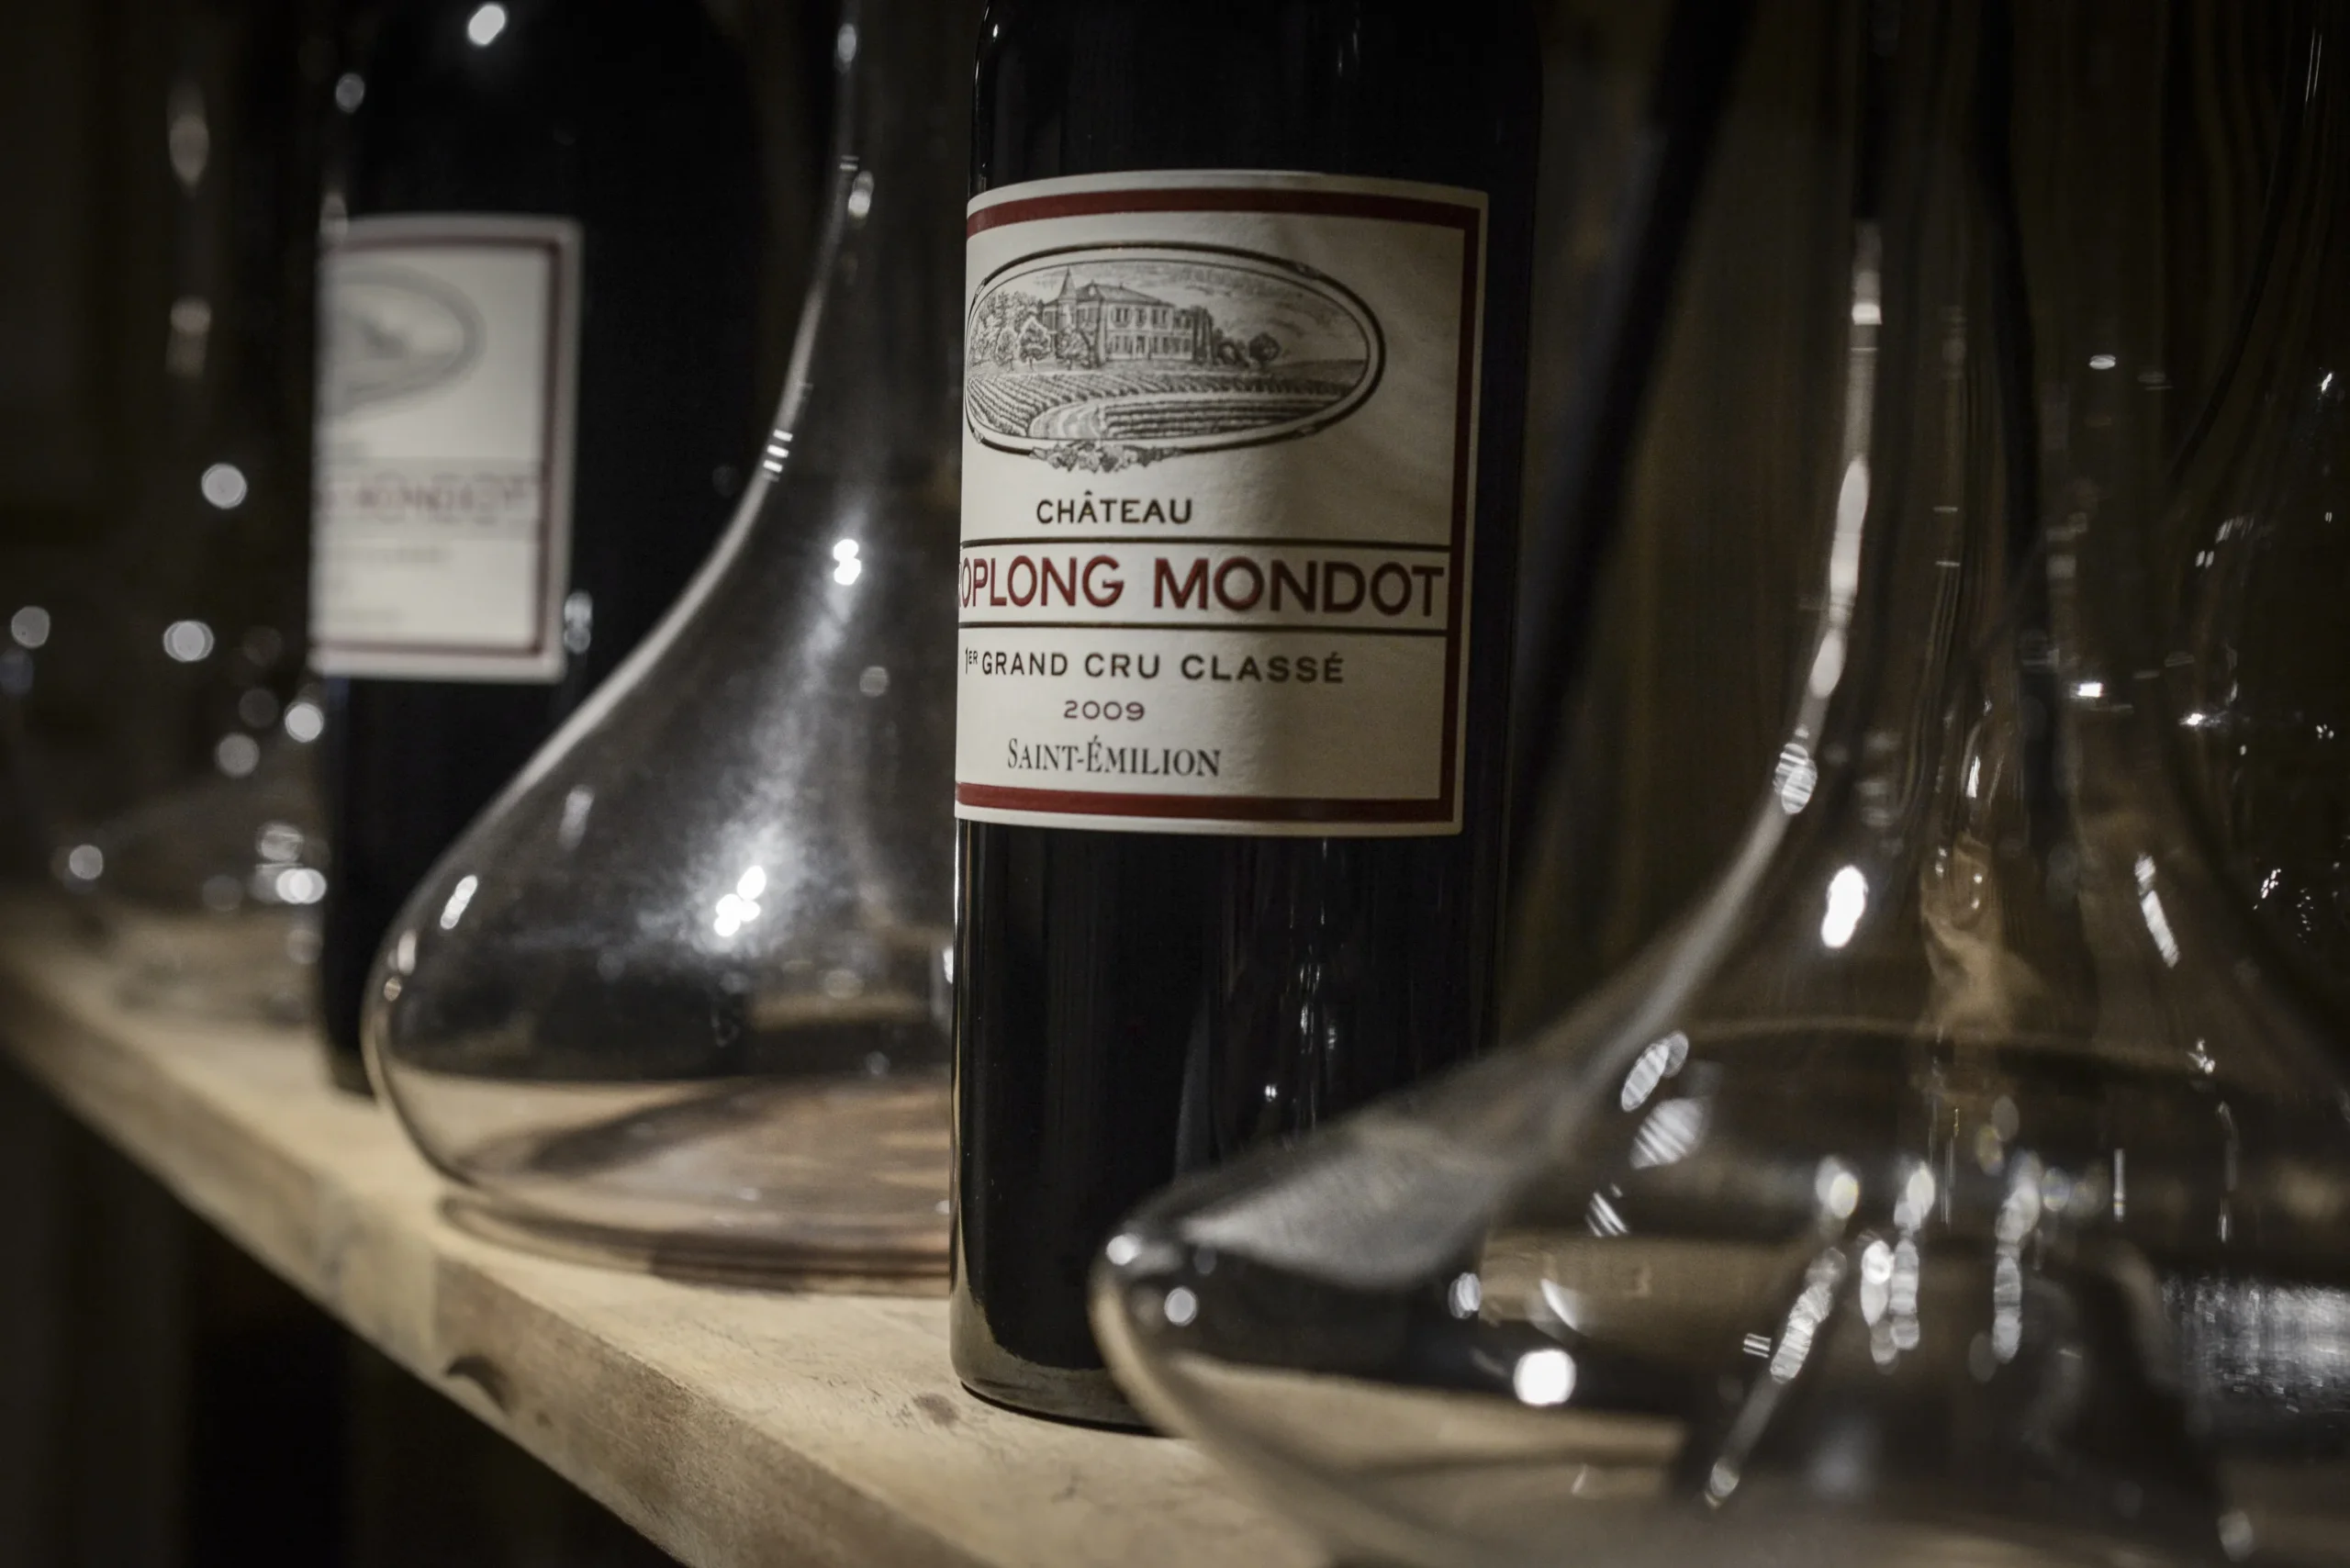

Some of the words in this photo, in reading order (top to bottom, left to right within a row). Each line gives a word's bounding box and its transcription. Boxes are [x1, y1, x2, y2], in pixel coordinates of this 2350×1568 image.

[1036, 490, 1192, 524] CHÂTEAU
[1153, 555, 1446, 617] MONDOT
[981, 651, 1069, 678] GRAND
[1084, 652, 1160, 679] CRU
[1181, 652, 1345, 684] CLASSÉ
[1063, 700, 1146, 722] 2009
